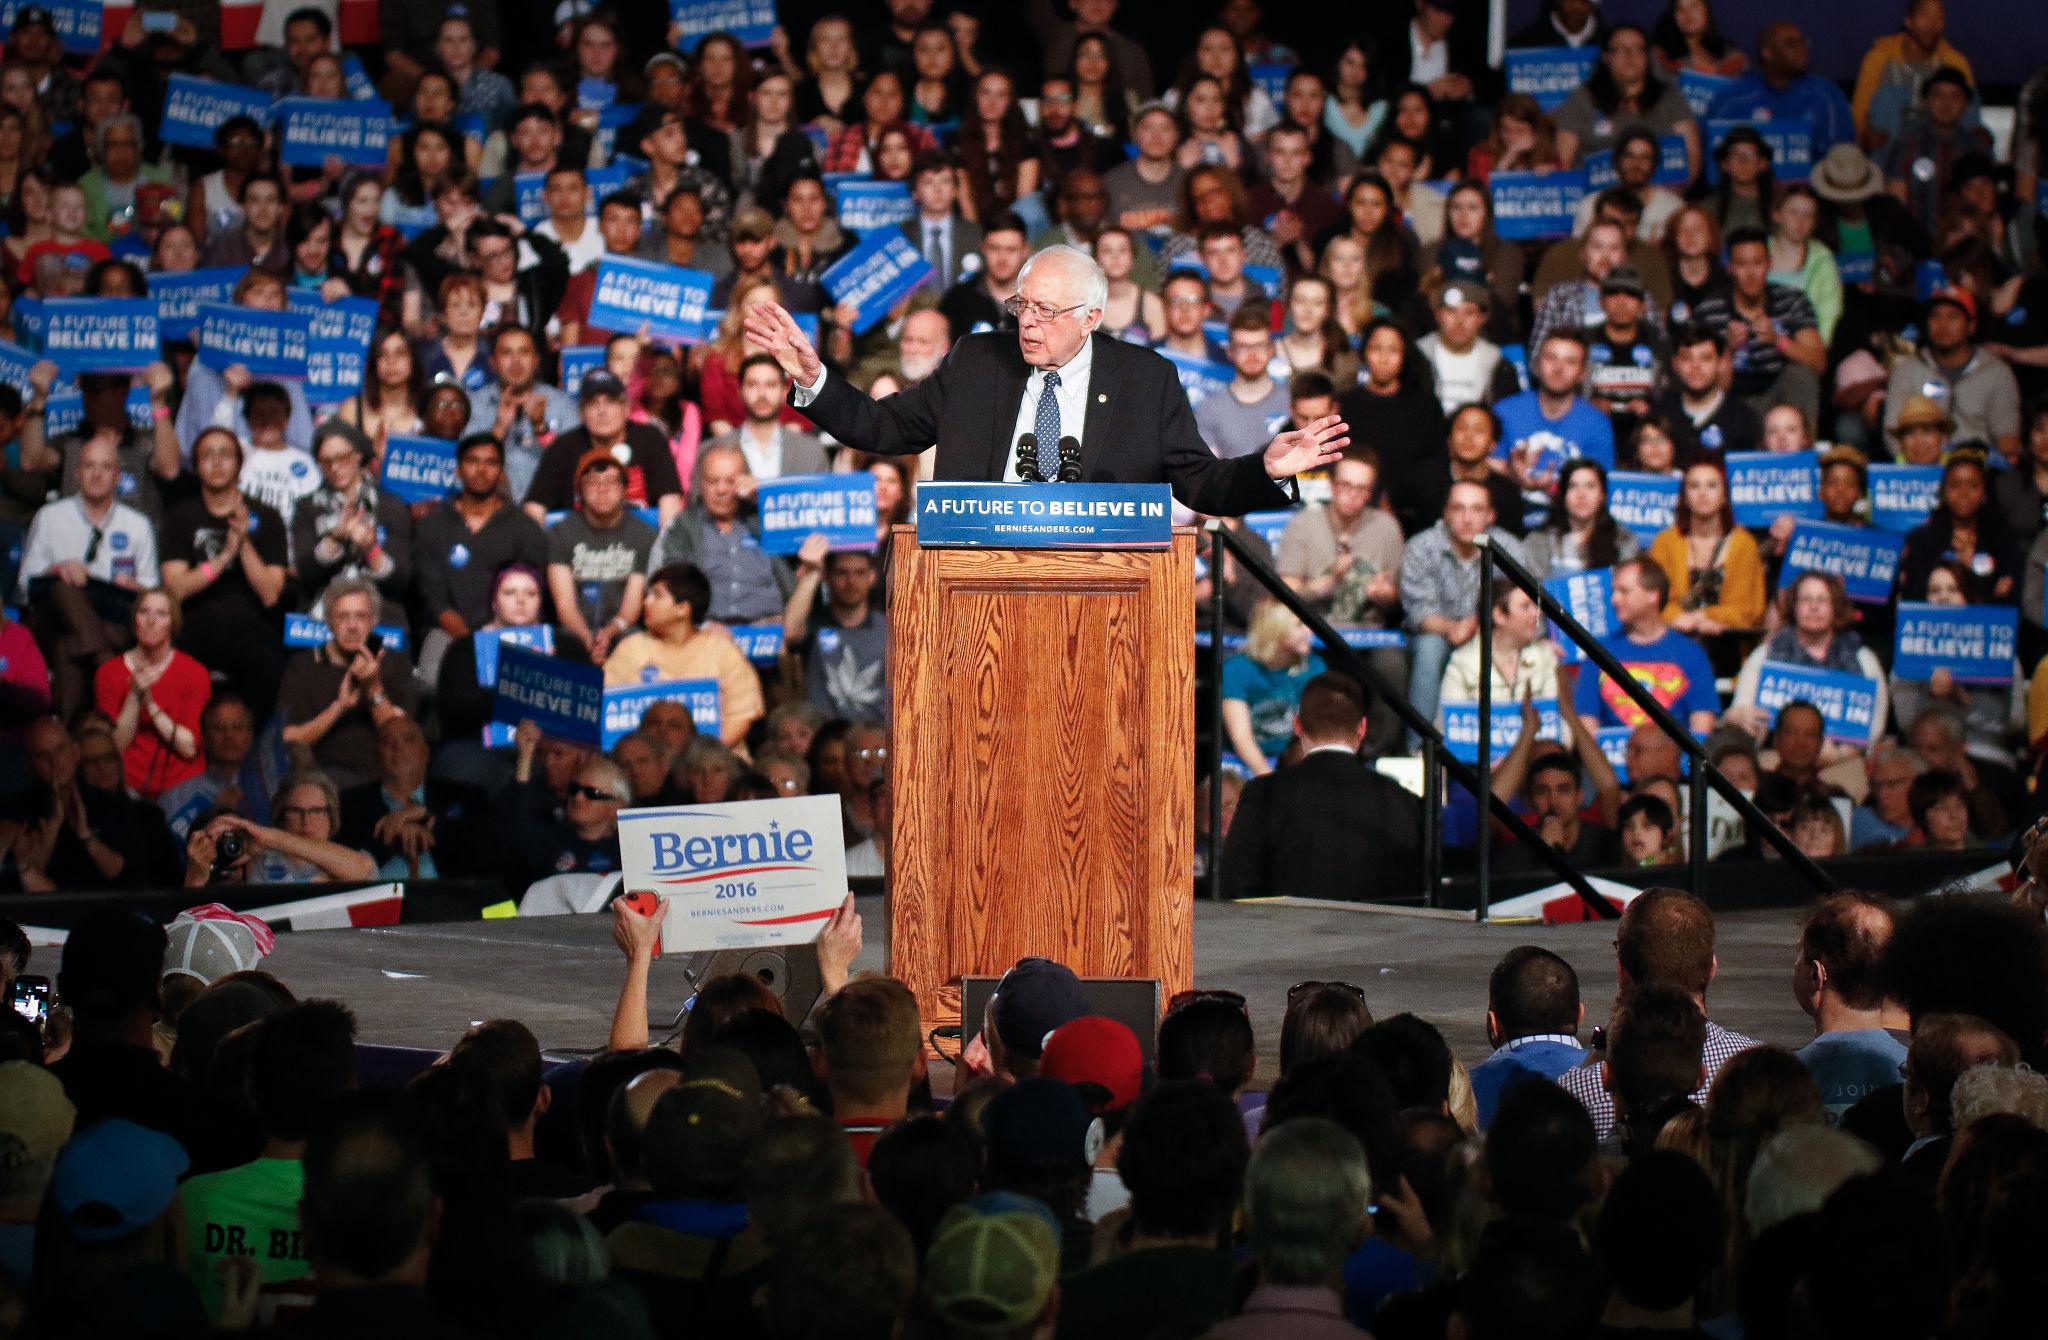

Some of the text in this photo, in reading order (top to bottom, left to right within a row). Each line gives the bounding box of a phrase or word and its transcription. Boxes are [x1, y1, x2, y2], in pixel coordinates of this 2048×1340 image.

[677, 9, 775, 34] BELIEVE IN
[183, 91, 240, 113] FUTURE
[167, 101, 226, 128] BELIEV
[302, 112, 361, 129] FUTURE
[365, 117, 386, 130] TO
[287, 125, 387, 149] BELIEVE IN
[1507, 186, 1562, 199] FUTURE
[1493, 200, 1563, 217] BELIEVE
[603, 270, 708, 304] A FUTURE TO
[598, 285, 704, 323] BELIEVE IN
[50, 314, 157, 330] A FUTURE TO
[203, 316, 214, 329] A
[217, 318, 278, 339] FUTURE
[284, 328, 306, 342] TO
[48, 330, 157, 350] BELIEVE IN
[202, 330, 279, 359] BELIEVE
[282, 344, 307, 361] IN
[337, 352, 361, 368] TO
[337, 368, 361, 386] IN
[390, 448, 457, 470] A FUTUR
[1732, 469, 1745, 483] A
[1747, 467, 1811, 482] FUTURE
[1875, 479, 1887, 491] A
[764, 490, 873, 510] A FUTURE TO
[1612, 488, 1624, 502] A
[1731, 484, 1812, 502] BELIEVE
[1874, 492, 1941, 512] BELIEV
[924, 499, 1164, 518] A FUTURE TO BELIEVE IN
[1609, 504, 1675, 525] BELIEV
[763, 507, 876, 532] BELIEVE IN
[994, 524, 1095, 534] BERNIESANDERS.COM
[1795, 535, 1898, 563] A FUTURE TO
[1789, 549, 1895, 582] BELIEVE IN
[1902, 619, 2013, 641] A FUTURE TO
[1900, 636, 2013, 661] BELIEVE IN
[501, 663, 600, 701] A FUTURE TO
[1763, 675, 1872, 708] A FUTURE TO
[498, 678, 572, 714] BELIEVE
[577, 703, 599, 724] IN
[606, 701, 618, 714] A
[692, 691, 716, 706] TO
[693, 706, 717, 723] IN
[1448, 712, 1460, 727] A
[1845, 705, 1870, 725] IN
[650, 820, 814, 872] Bernie
[715, 882, 757, 900] 2016
[691, 903, 785, 918] BERNIESANDERS.COM
[204, 1222, 311, 1260] DR. BI
